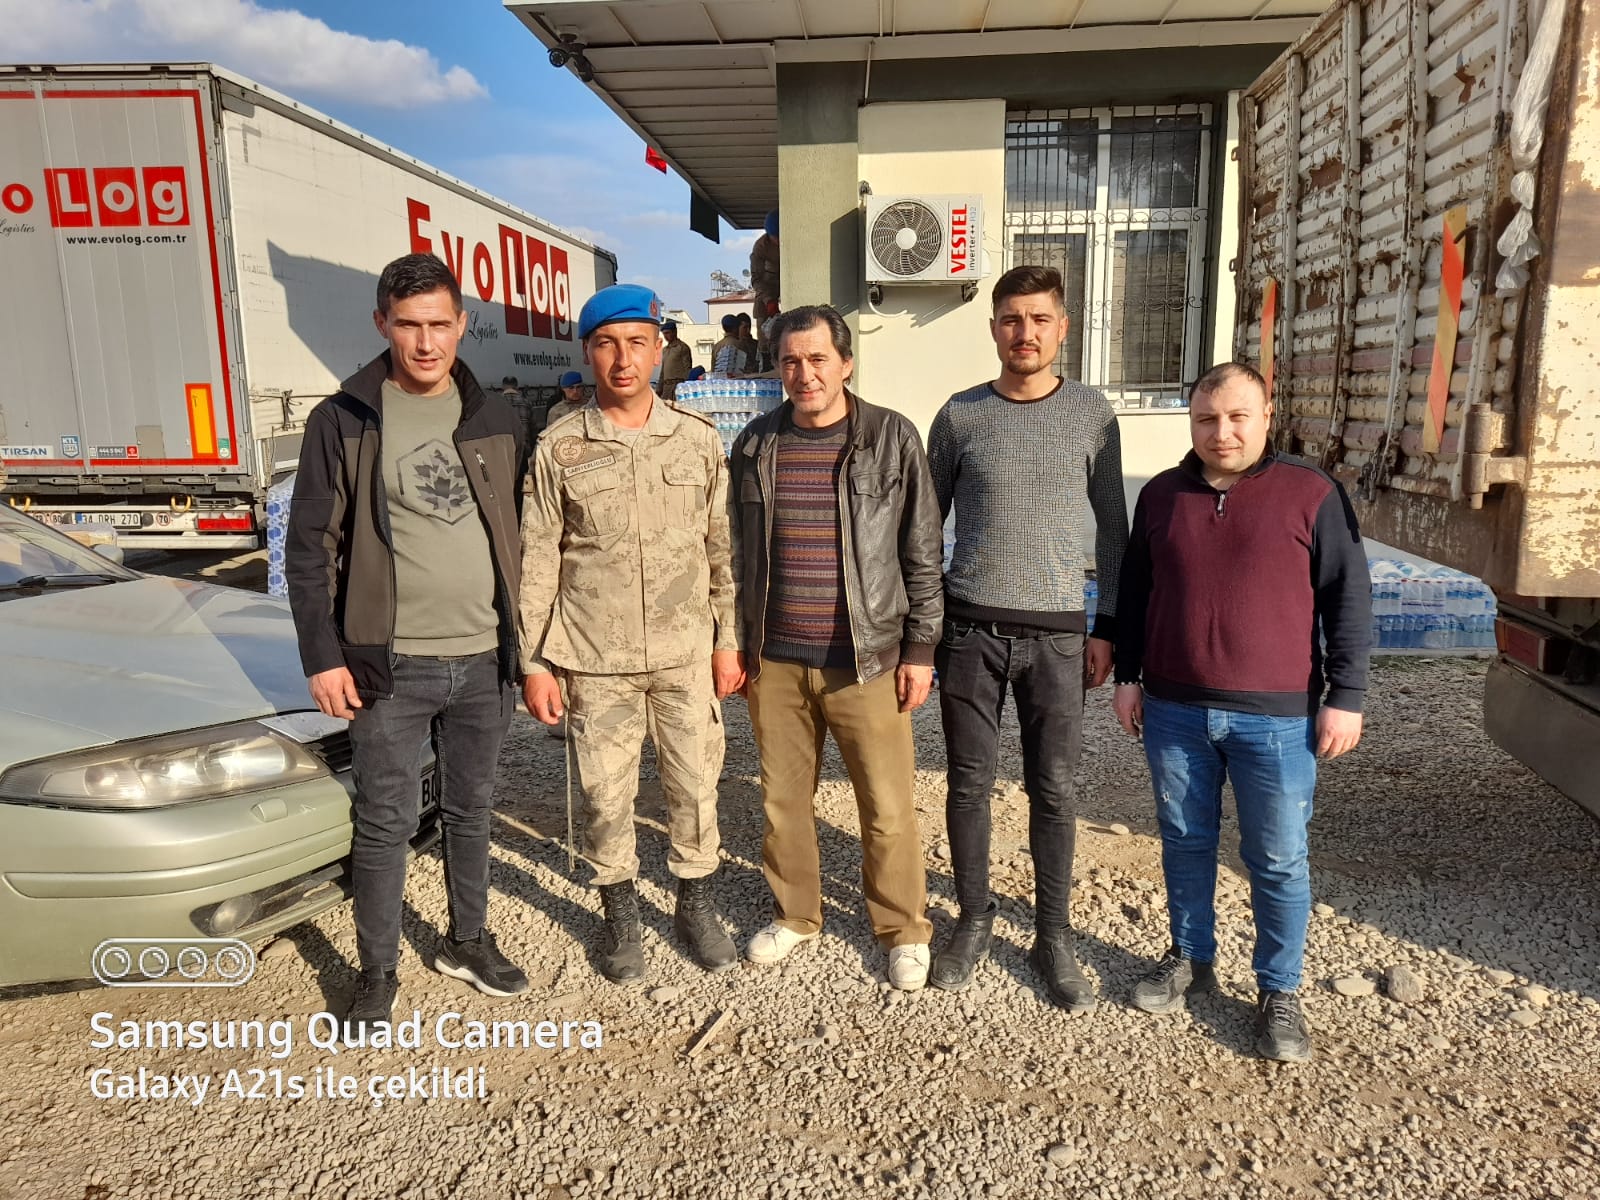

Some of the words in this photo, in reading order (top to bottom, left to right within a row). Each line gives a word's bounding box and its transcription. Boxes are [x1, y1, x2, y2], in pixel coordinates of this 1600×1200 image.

[67, 234, 187, 246] www.evolog.com.tr
[951, 204, 967, 273] VESTEL
[2, 447, 47, 456] TIRSAN
[122, 514, 139, 525] 270
[160, 515, 169, 524] 70
